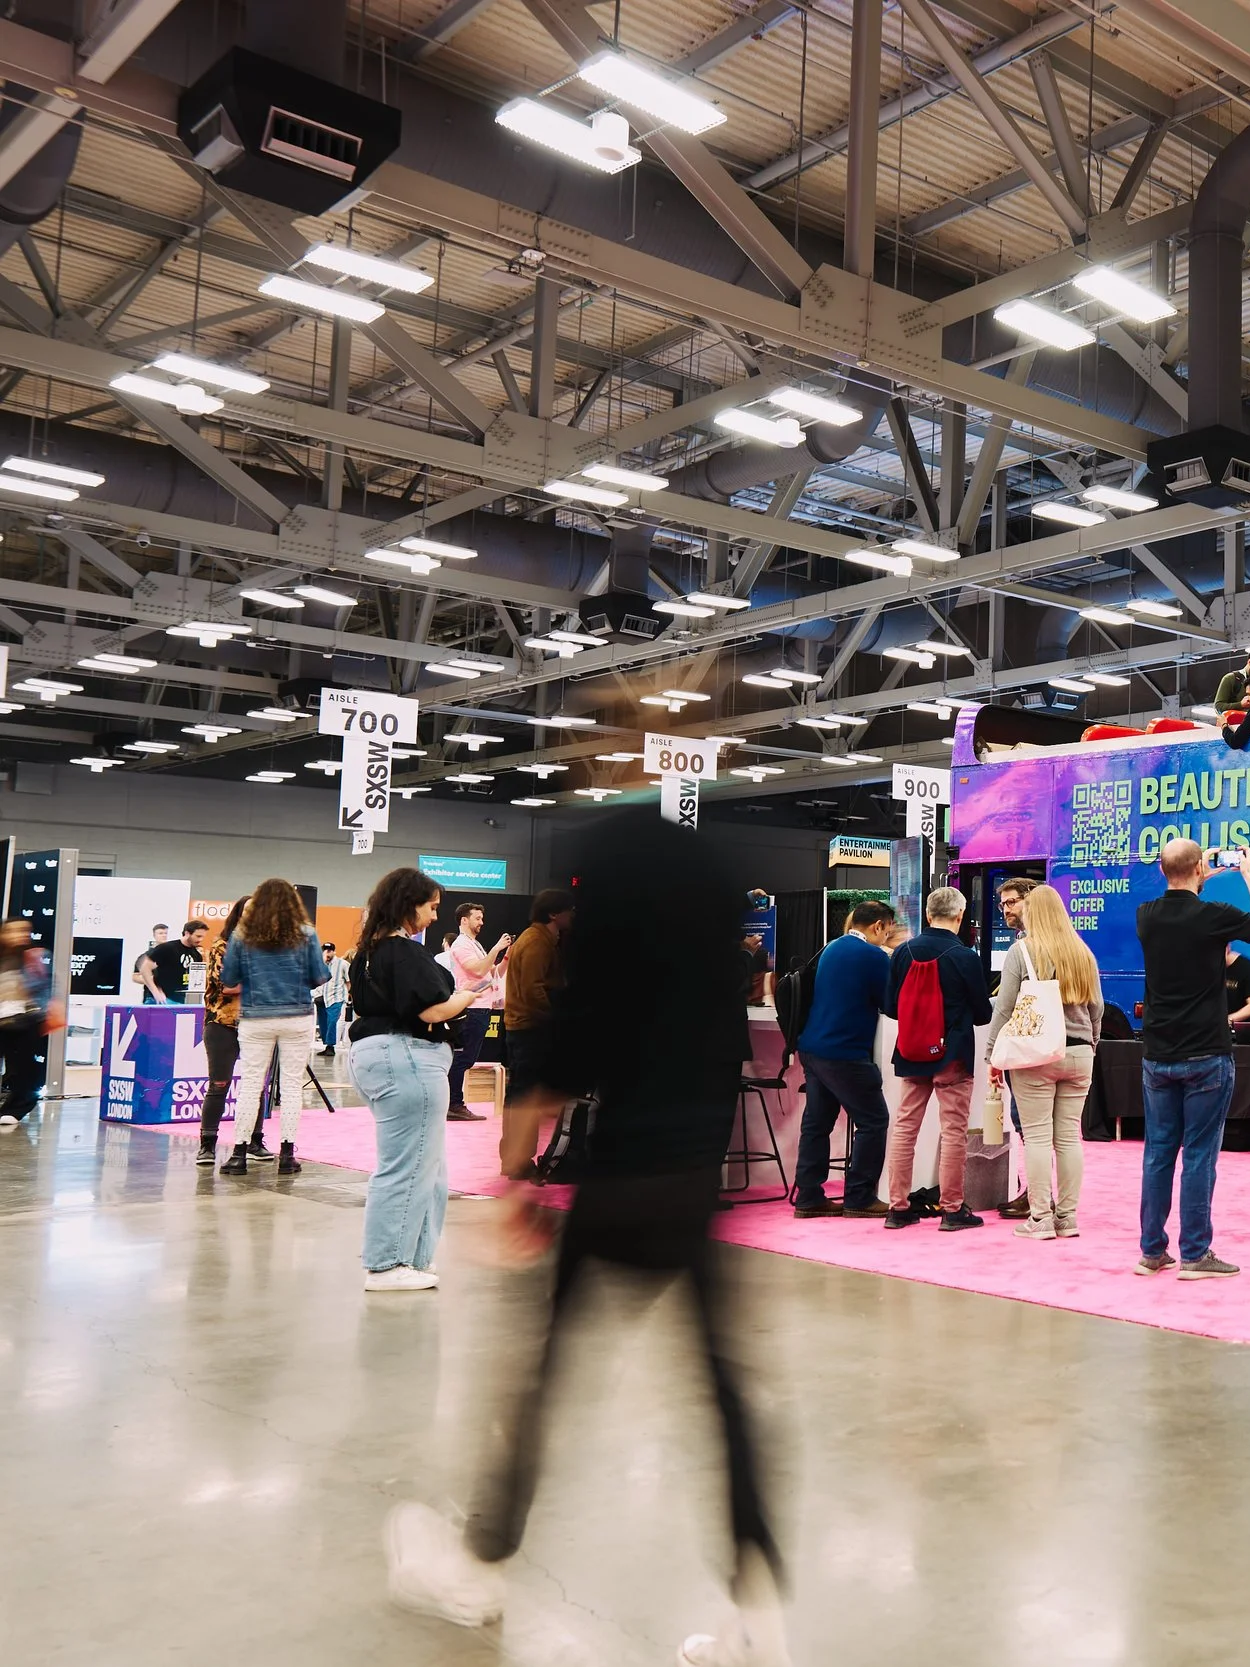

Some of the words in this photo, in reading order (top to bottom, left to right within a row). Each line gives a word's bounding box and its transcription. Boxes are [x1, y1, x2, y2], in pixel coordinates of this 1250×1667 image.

[328, 693, 358, 704] AISLE
[341, 707, 399, 736] 700
[650, 737, 673, 747] AISLE
[658, 749, 704, 774] 800
[364, 740, 389, 810] SXSW
[897, 768, 915, 776] AISLE
[904, 778, 940, 799] 900
[357, 839, 368, 849] 700
[839, 838, 890, 851] ENTERTAINME
[839, 847, 873, 859] PAVILION
[1070, 878, 1130, 895] EXCLUSIVE
[195, 903, 231, 917] flod
[1070, 897, 1105, 913] OFFER
[1070, 915, 1098, 931] HERE
[71, 954, 96, 962] ROOF
[108, 1079, 135, 1102] SXSW
[107, 1102, 133, 1120] LONDON
